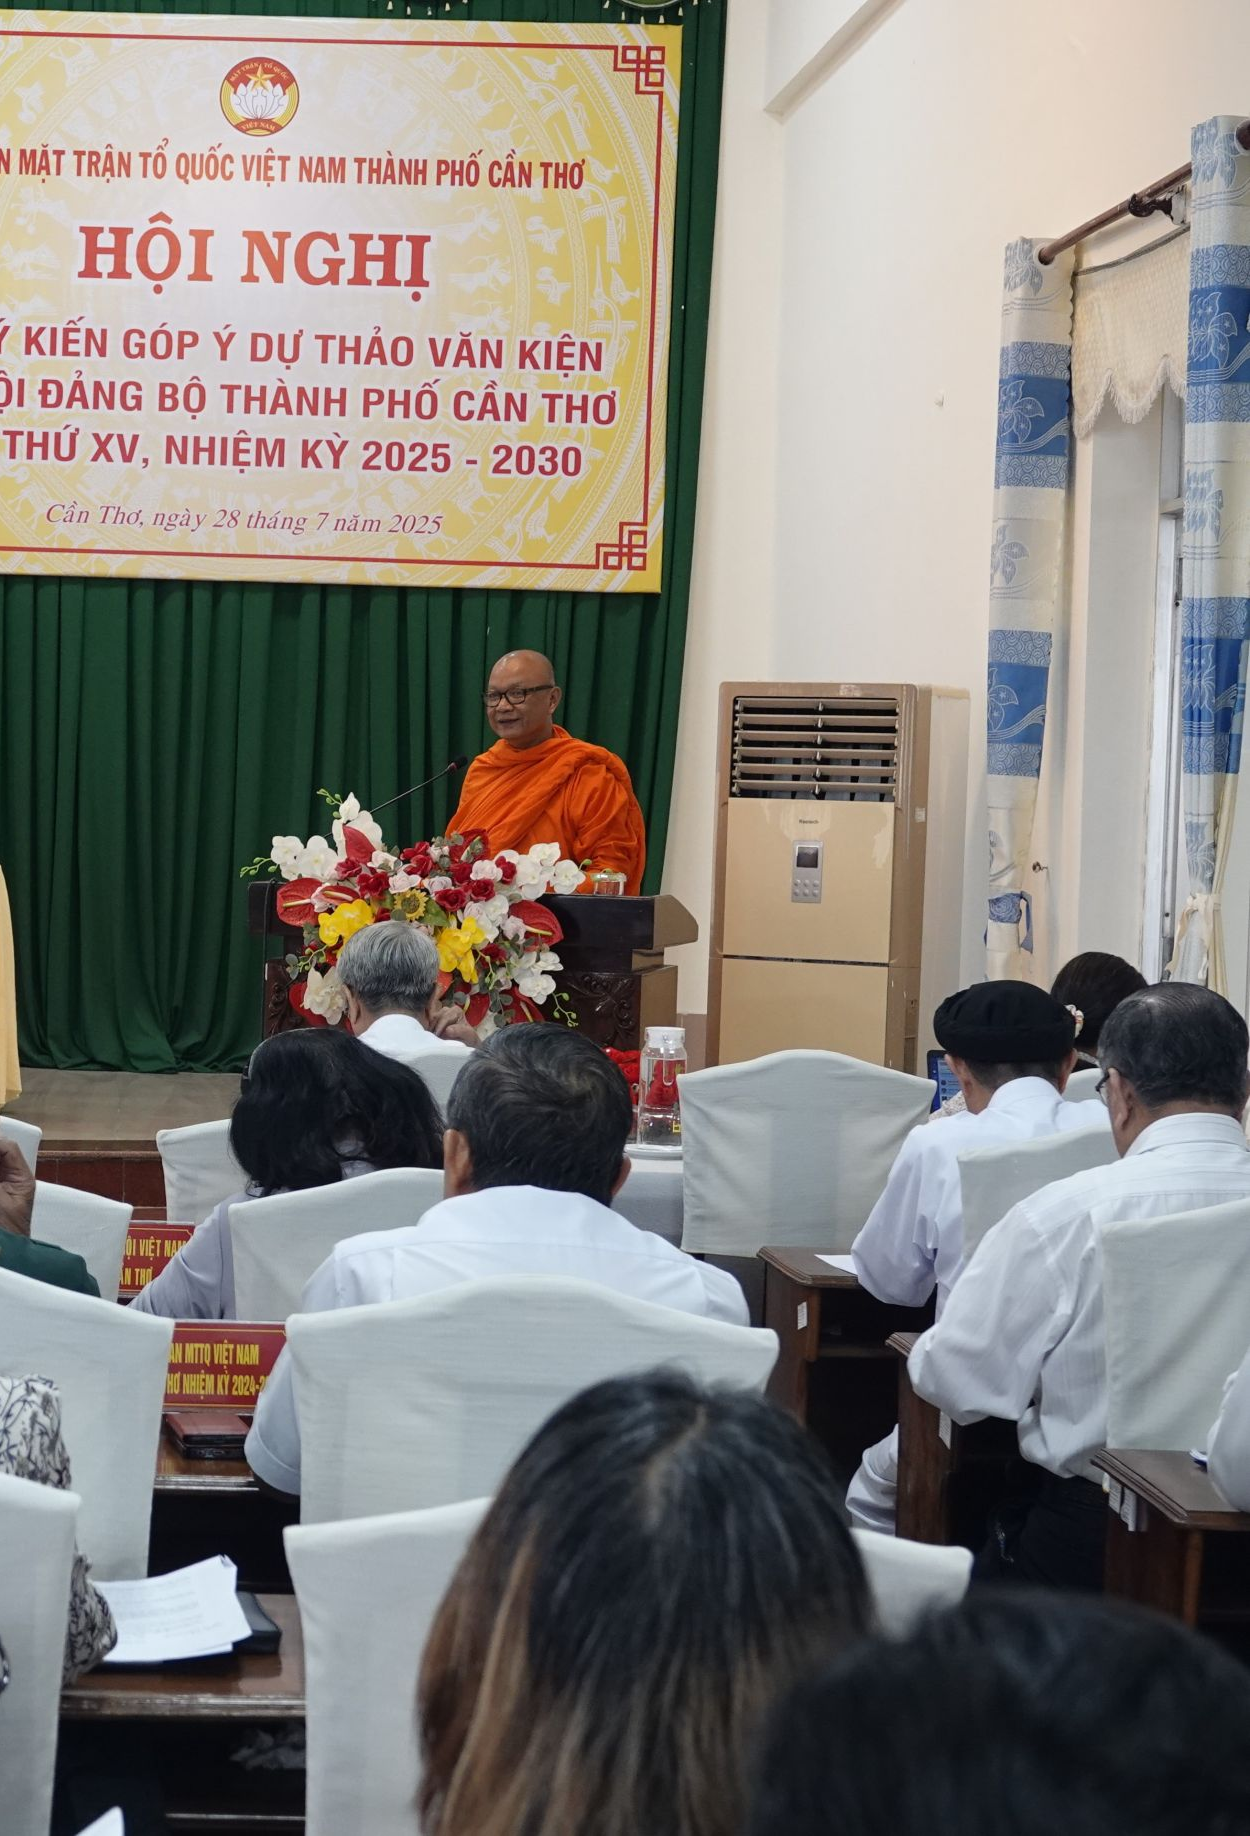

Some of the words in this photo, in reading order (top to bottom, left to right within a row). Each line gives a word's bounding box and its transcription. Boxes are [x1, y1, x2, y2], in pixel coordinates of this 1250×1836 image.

[18, 144, 66, 183] MẶT
[73, 144, 131, 183] TRẬN
[139, 138, 169, 180] TỔ
[175, 143, 234, 185] QUỐC
[241, 147, 291, 187] VIỆT
[299, 155, 346, 184] NAM
[354, 151, 427, 185] THÀNH
[436, 150, 483, 187] PHỐ
[488, 149, 533, 188] CẦN
[540, 159, 586, 190] THƠ
[77, 211, 215, 295] HỘI
[241, 230, 431, 302] NGHỊ
[24, 316, 108, 358] KIẾN
[123, 322, 199, 360] GÓP
[213, 324, 237, 362] Ý
[250, 329, 304, 371] DỰ
[314, 326, 414, 368] THẢO
[428, 331, 503, 369] VĂN
[518, 333, 602, 378] KIỆN
[38, 370, 143, 412] ĐẢNG
[158, 375, 207, 420] BỘ
[219, 377, 348, 418] THÀNH
[362, 378, 442, 420] PHỐ
[452, 380, 528, 422] CẦN
[542, 390, 617, 426] THƠ
[2, 424, 80, 462] THỨ
[90, 432, 150, 469] XV,
[165, 428, 286, 475] NHIỆM
[301, 432, 349, 470] KỲ
[361, 440, 451, 473] 2025
[465, 458, 478, 466] -
[492, 444, 582, 477] 2030
[46, 501, 89, 524] Cần
[99, 505, 143, 528] Thơ,
[152, 508, 206, 532] ngày
[213, 508, 241, 529] 28
[246, 509, 307, 535] tháng
[316, 512, 329, 529] 7
[333, 514, 381, 532] năm
[388, 514, 444, 534] 2025
[126, 1235, 136, 1260] ỘI
[140, 1235, 161, 1260] VIỆT
[168, 1343, 182, 1363] AN
[185, 1343, 211, 1367] MTTQ
[213, 1339, 234, 1369] VIỆT
[236, 1344, 259, 1365] NAM
[167, 1371, 180, 1395] HƠ
[183, 1369, 214, 1400] NHIỆM
[217, 1370, 230, 1395] KỲ
